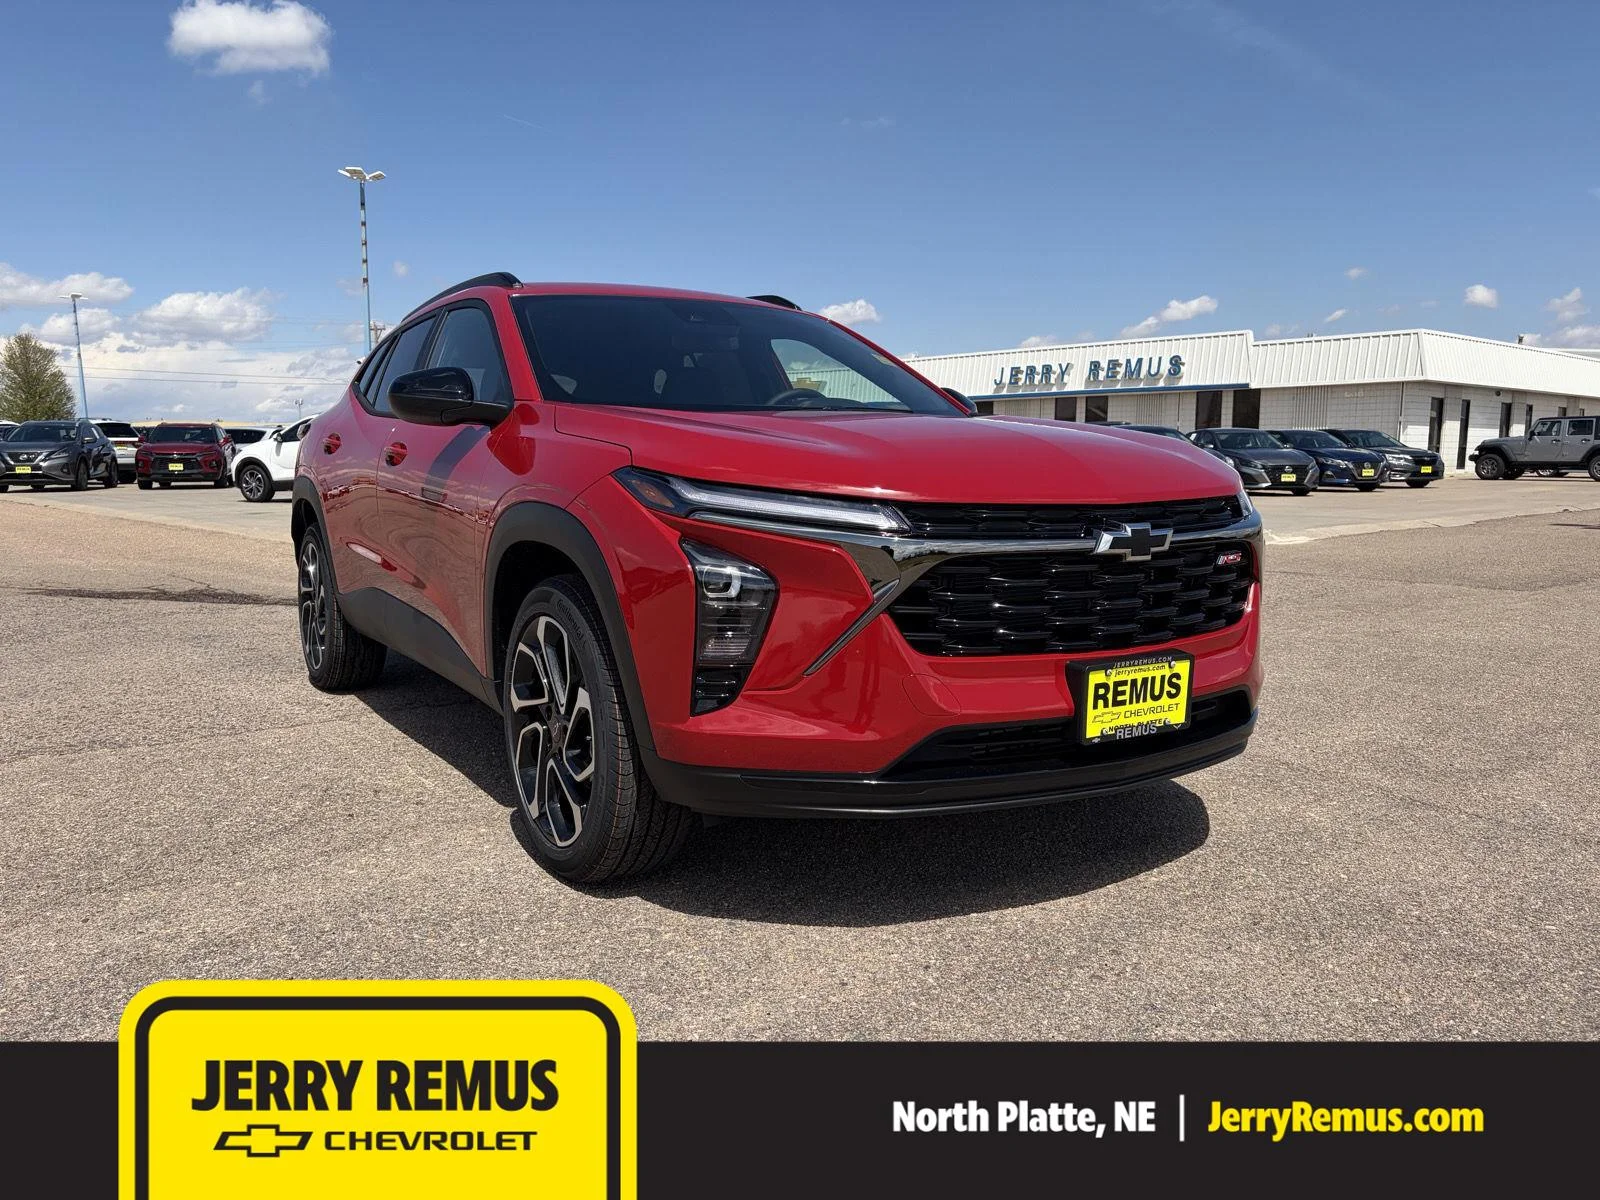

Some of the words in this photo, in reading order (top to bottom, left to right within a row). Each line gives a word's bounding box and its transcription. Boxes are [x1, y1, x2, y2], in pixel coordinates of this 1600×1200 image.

[994, 363, 1071, 386] JERRY
[1088, 355, 1185, 381] REMUS
[1113, 656, 1172, 668] JERRYREMUS.COM
[1114, 665, 1166, 677] jerryremus.com
[1093, 672, 1182, 710] REMUS
[1123, 703, 1180, 719] CHEVROLET
[1116, 723, 1157, 740] REMUS
